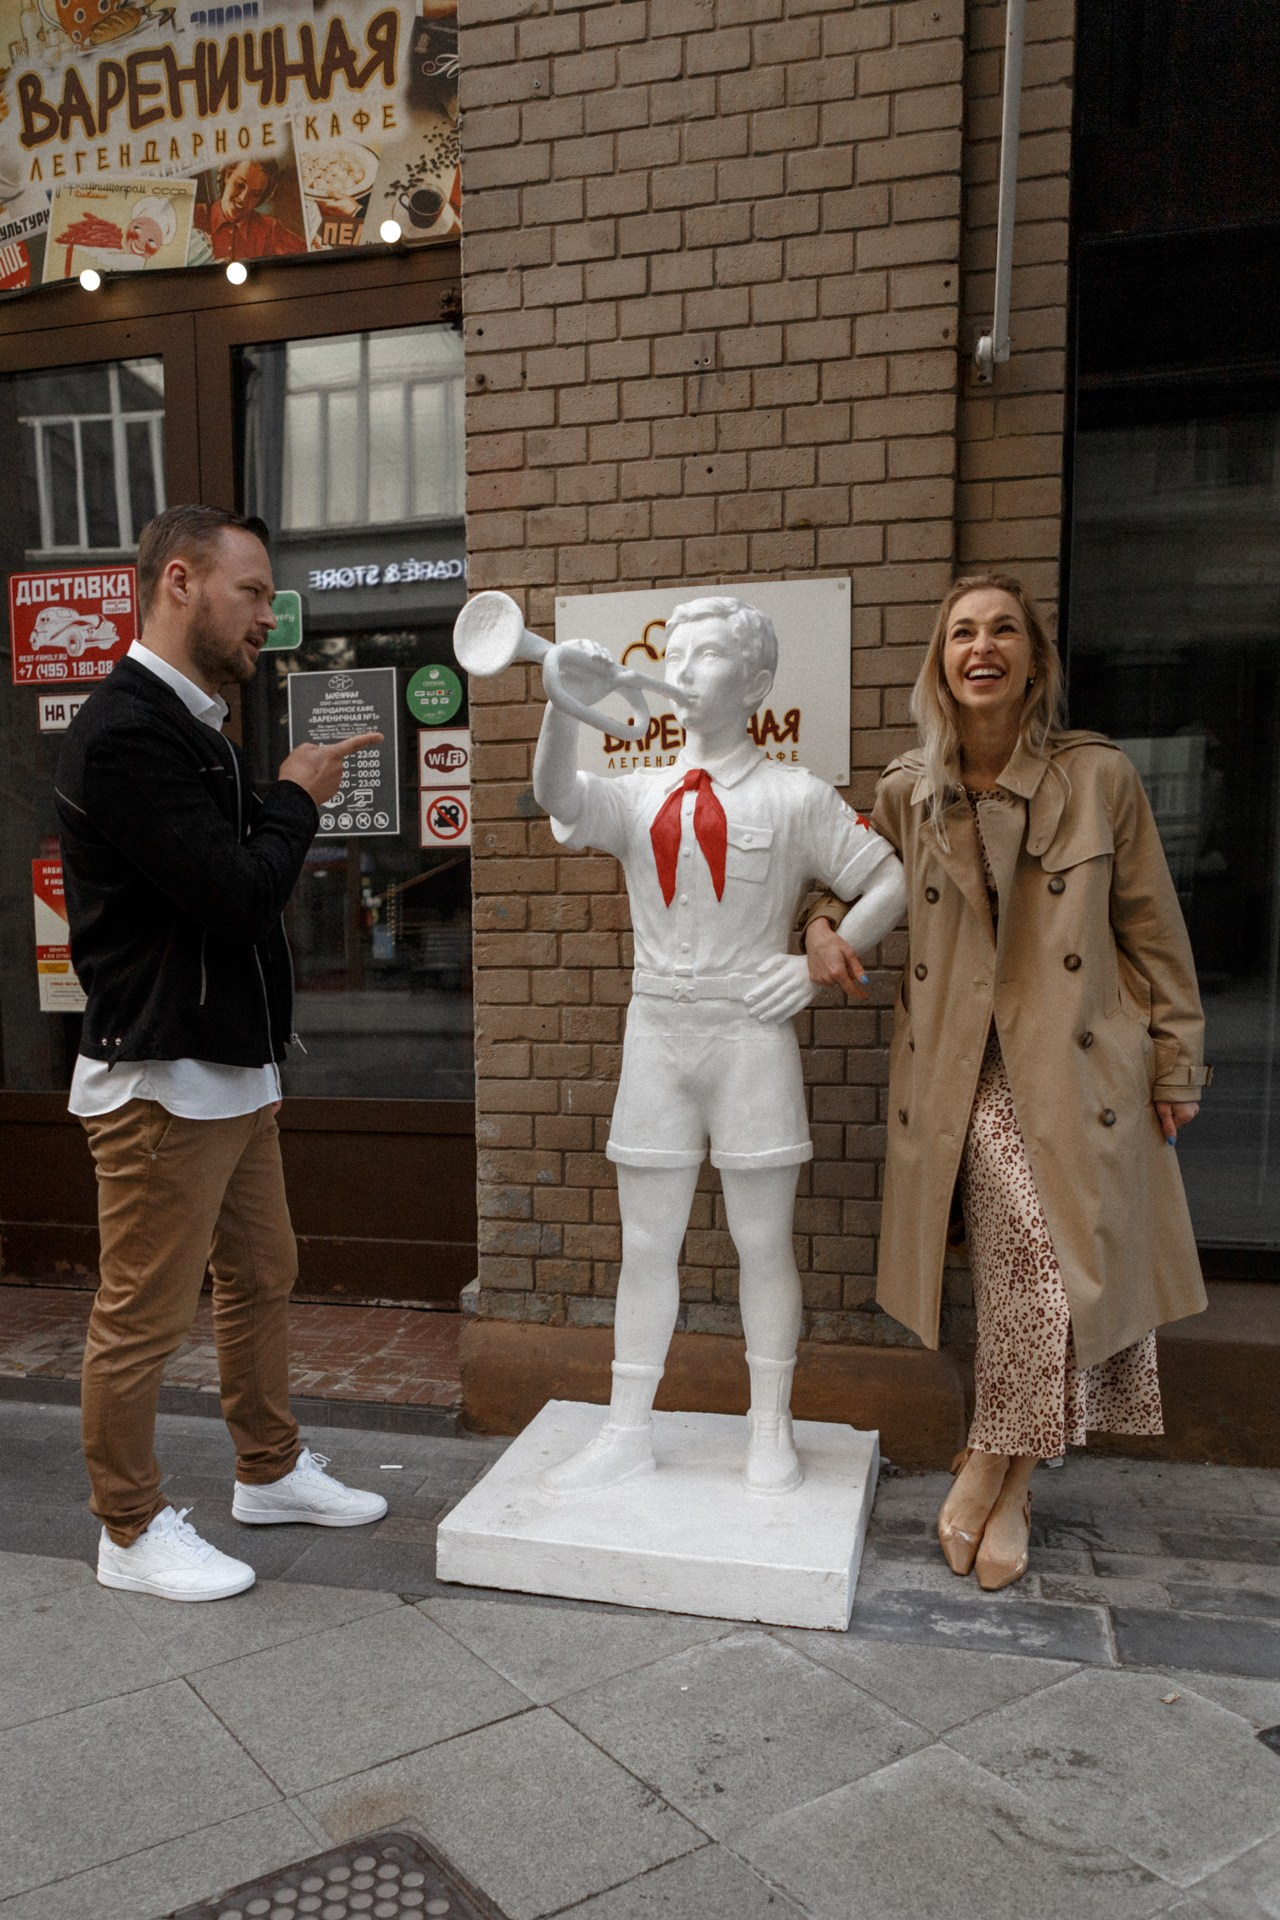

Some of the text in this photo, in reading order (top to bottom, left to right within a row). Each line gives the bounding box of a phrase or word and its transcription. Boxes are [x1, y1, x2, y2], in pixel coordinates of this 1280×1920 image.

[18, 9, 399, 149] ВАРЕНИЧНАЯ
[30, 121, 276, 182] ЛЕГЕНДАРНОЕ
[304, 103, 397, 142] КАФЕ
[0, 208, 50, 242] УЛЬТУРН
[15, 573, 131, 606] ДОСТАВКА
[18, 653, 68, 662] REST-FAMILY.RU
[18, 663, 33, 679] +7
[36, 662, 68, 679] (495)
[45, 704, 65, 721] НА
[312, 706, 355, 714] ЛЕГЕНДАРНОЕ
[357, 750, 380, 759] 23:00
[357, 759, 380, 768] 00:00
[358, 769, 380, 778] 00:00
[358, 779, 381, 788] 23:00
